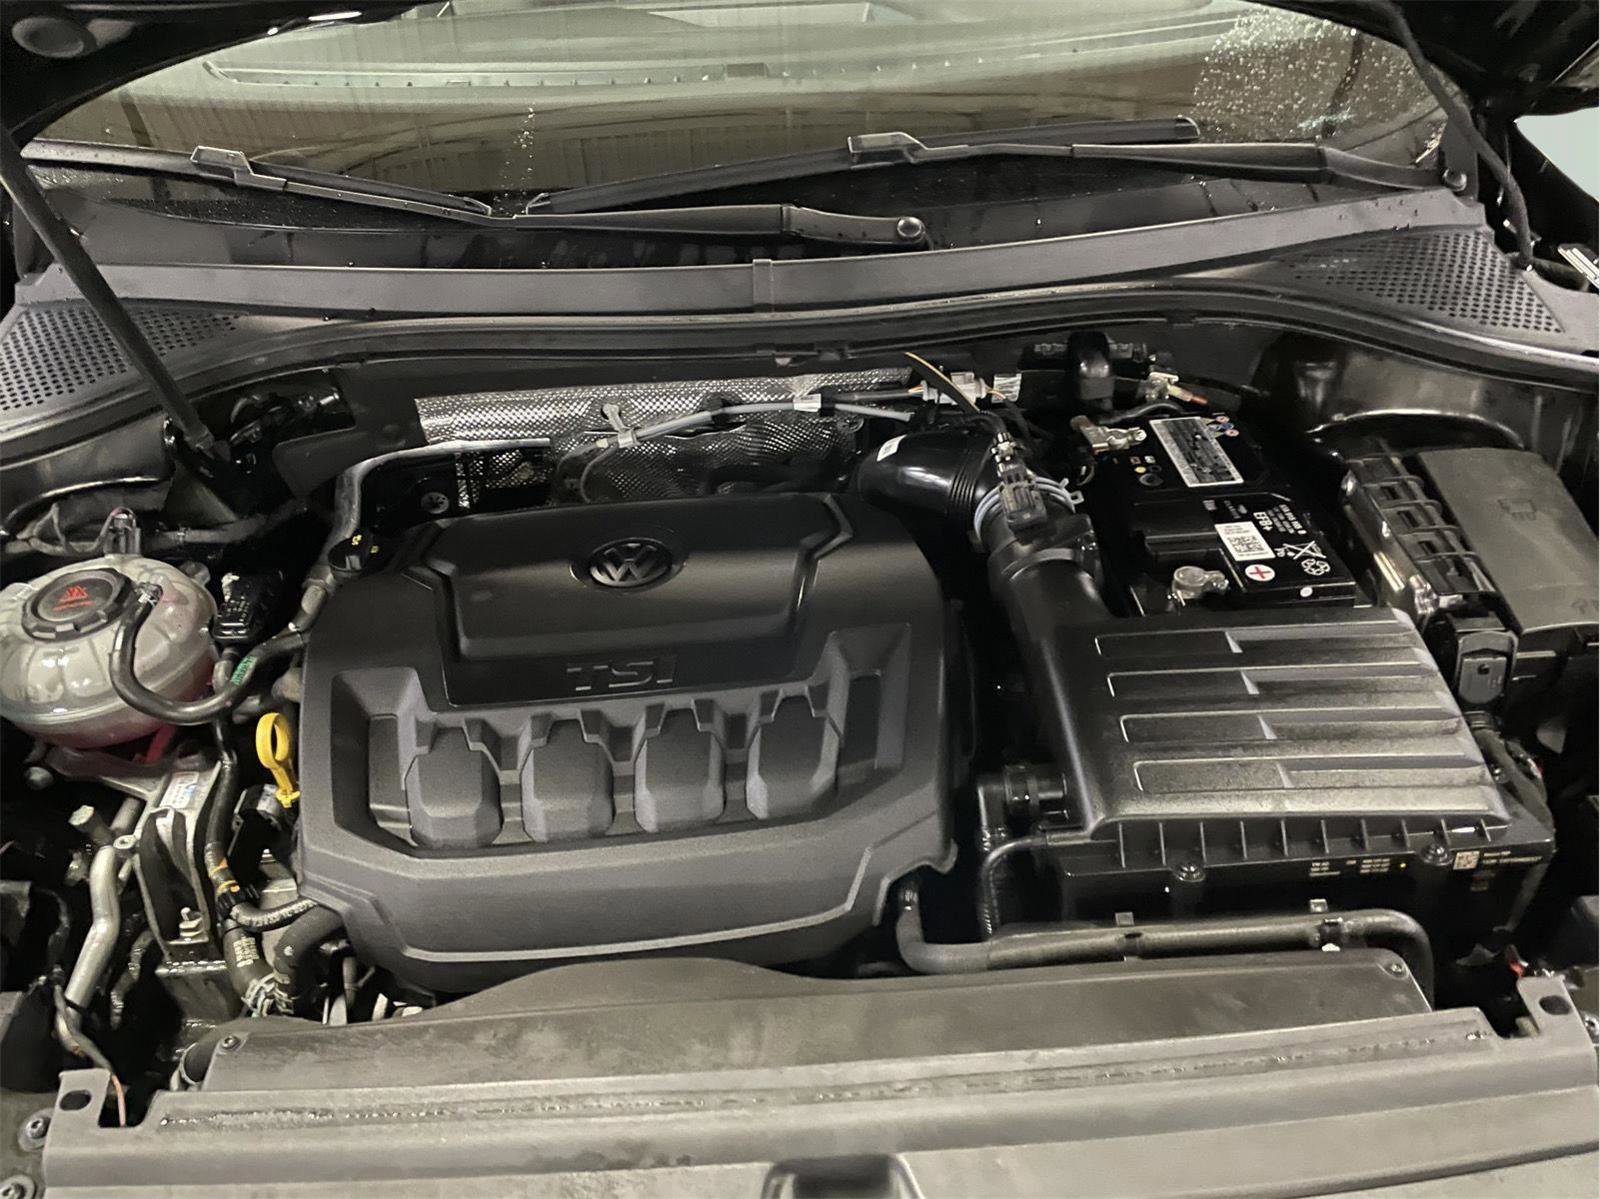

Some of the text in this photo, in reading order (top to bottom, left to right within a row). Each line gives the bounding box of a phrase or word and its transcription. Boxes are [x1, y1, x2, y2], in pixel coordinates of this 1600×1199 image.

[1253, 511, 1273, 531] EFB+
[589, 537, 673, 588] VW
[566, 660, 675, 692] TSI
